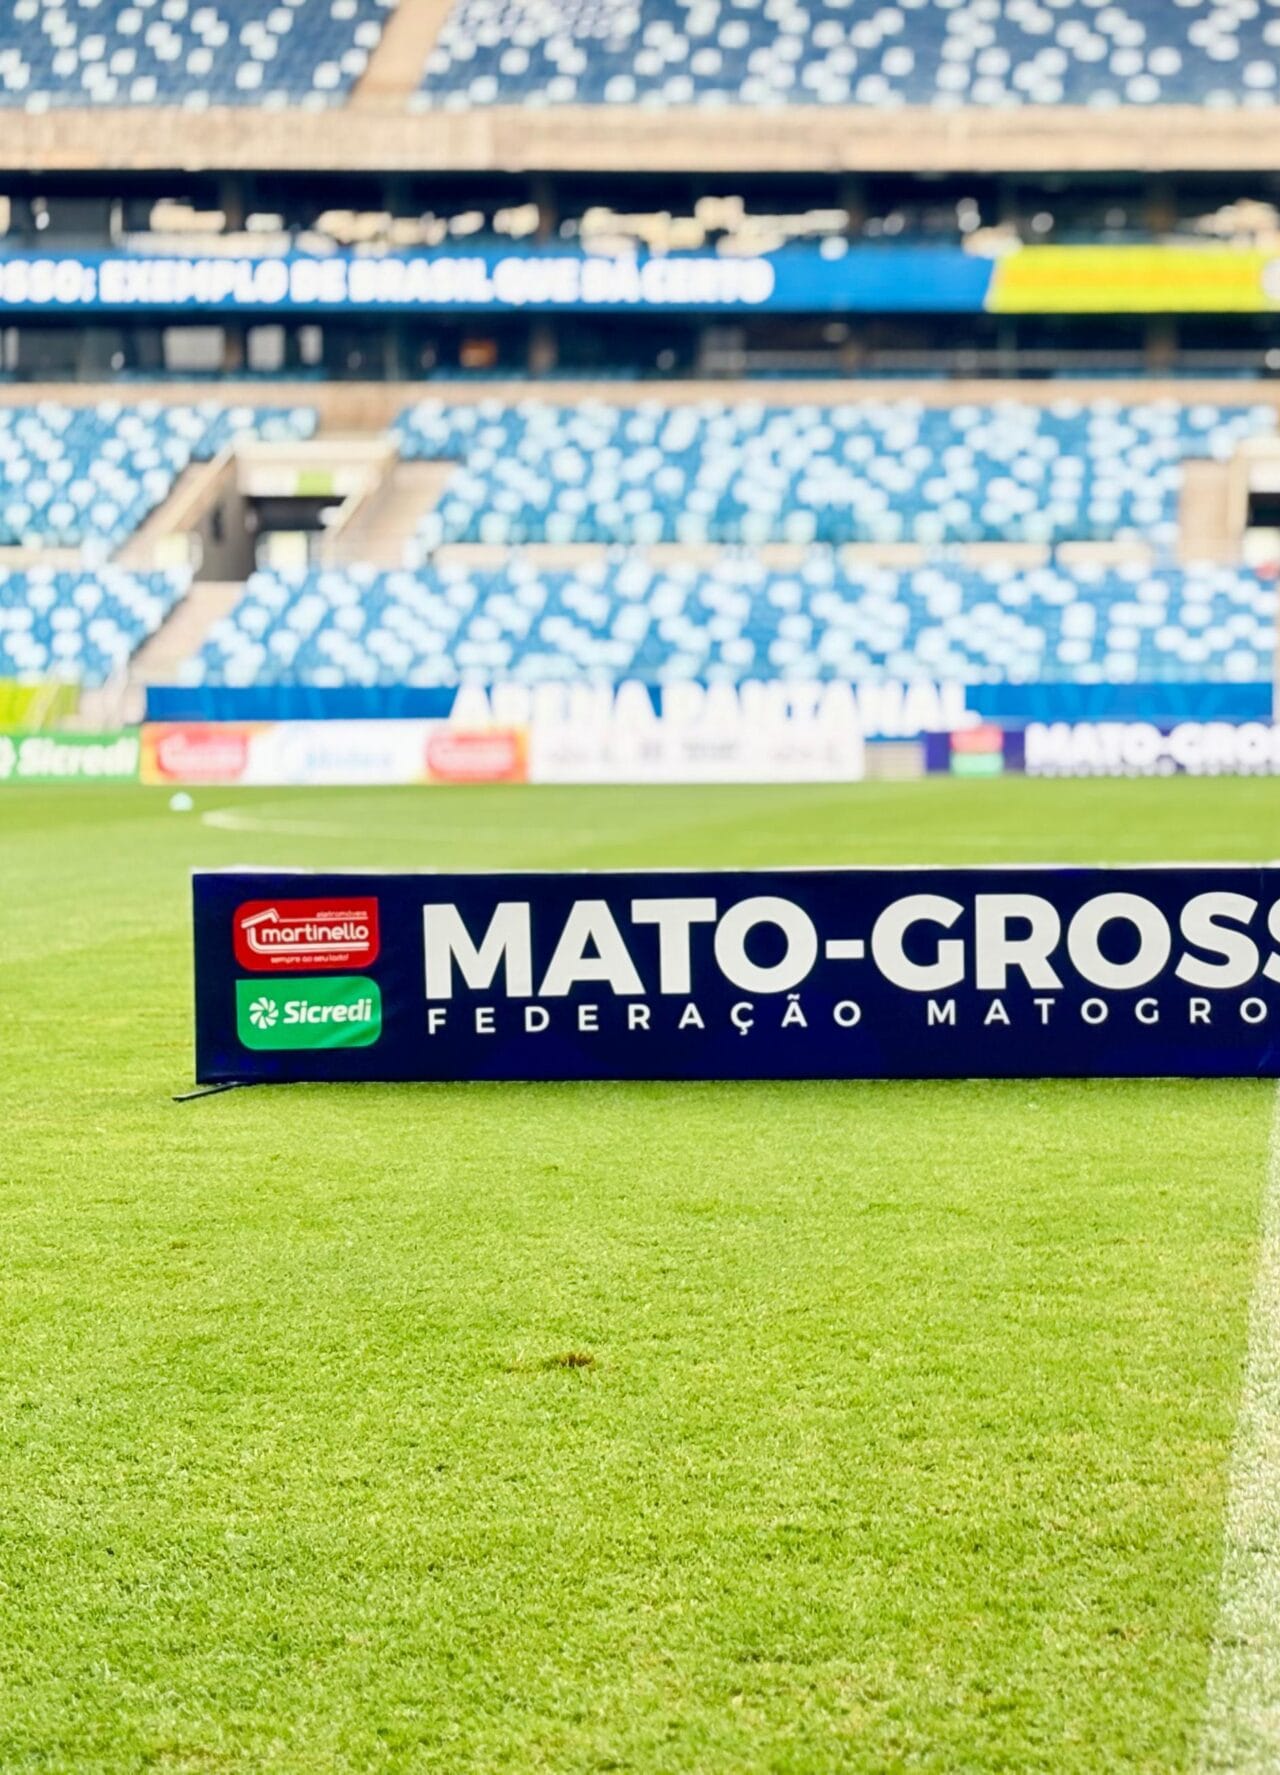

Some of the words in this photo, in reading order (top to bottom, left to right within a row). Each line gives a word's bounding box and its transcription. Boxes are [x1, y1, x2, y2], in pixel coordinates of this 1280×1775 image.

[100, 258, 289, 303] EXEMPLO
[290, 258, 347, 303] DE
[262, 922, 369, 943] martinello
[283, 998, 372, 1024] Sicredi
[429, 994, 860, 1035] FEDERAÇÃO
